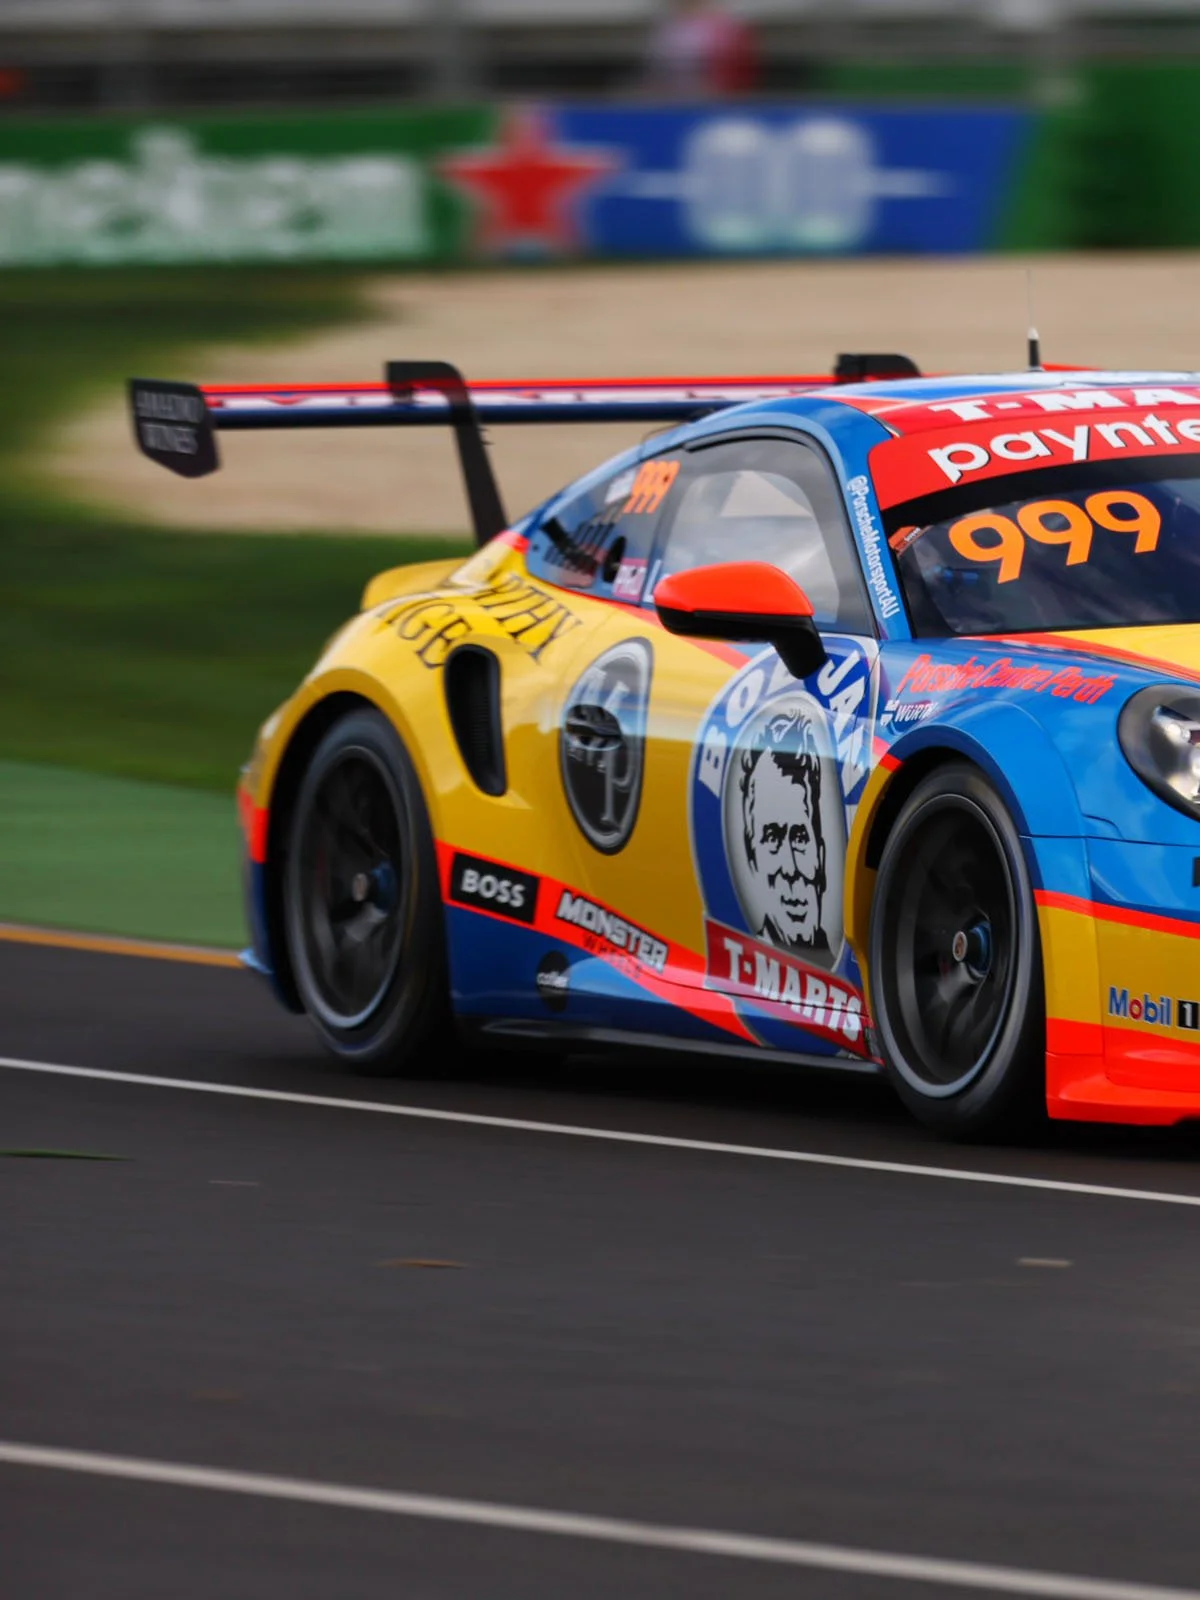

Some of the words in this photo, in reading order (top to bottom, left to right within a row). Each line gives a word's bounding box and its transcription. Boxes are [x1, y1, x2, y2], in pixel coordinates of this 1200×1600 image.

[948, 491, 1162, 584] 999
[896, 653, 985, 694] Porsche
[971, 657, 1053, 690] Centre
[1037, 665, 1120, 705] Perth
[460, 868, 526, 908] BOSS
[556, 889, 669, 974] MONSTER
[1108, 985, 1172, 1027] Mobil
[1181, 1001, 1197, 1028] 1
